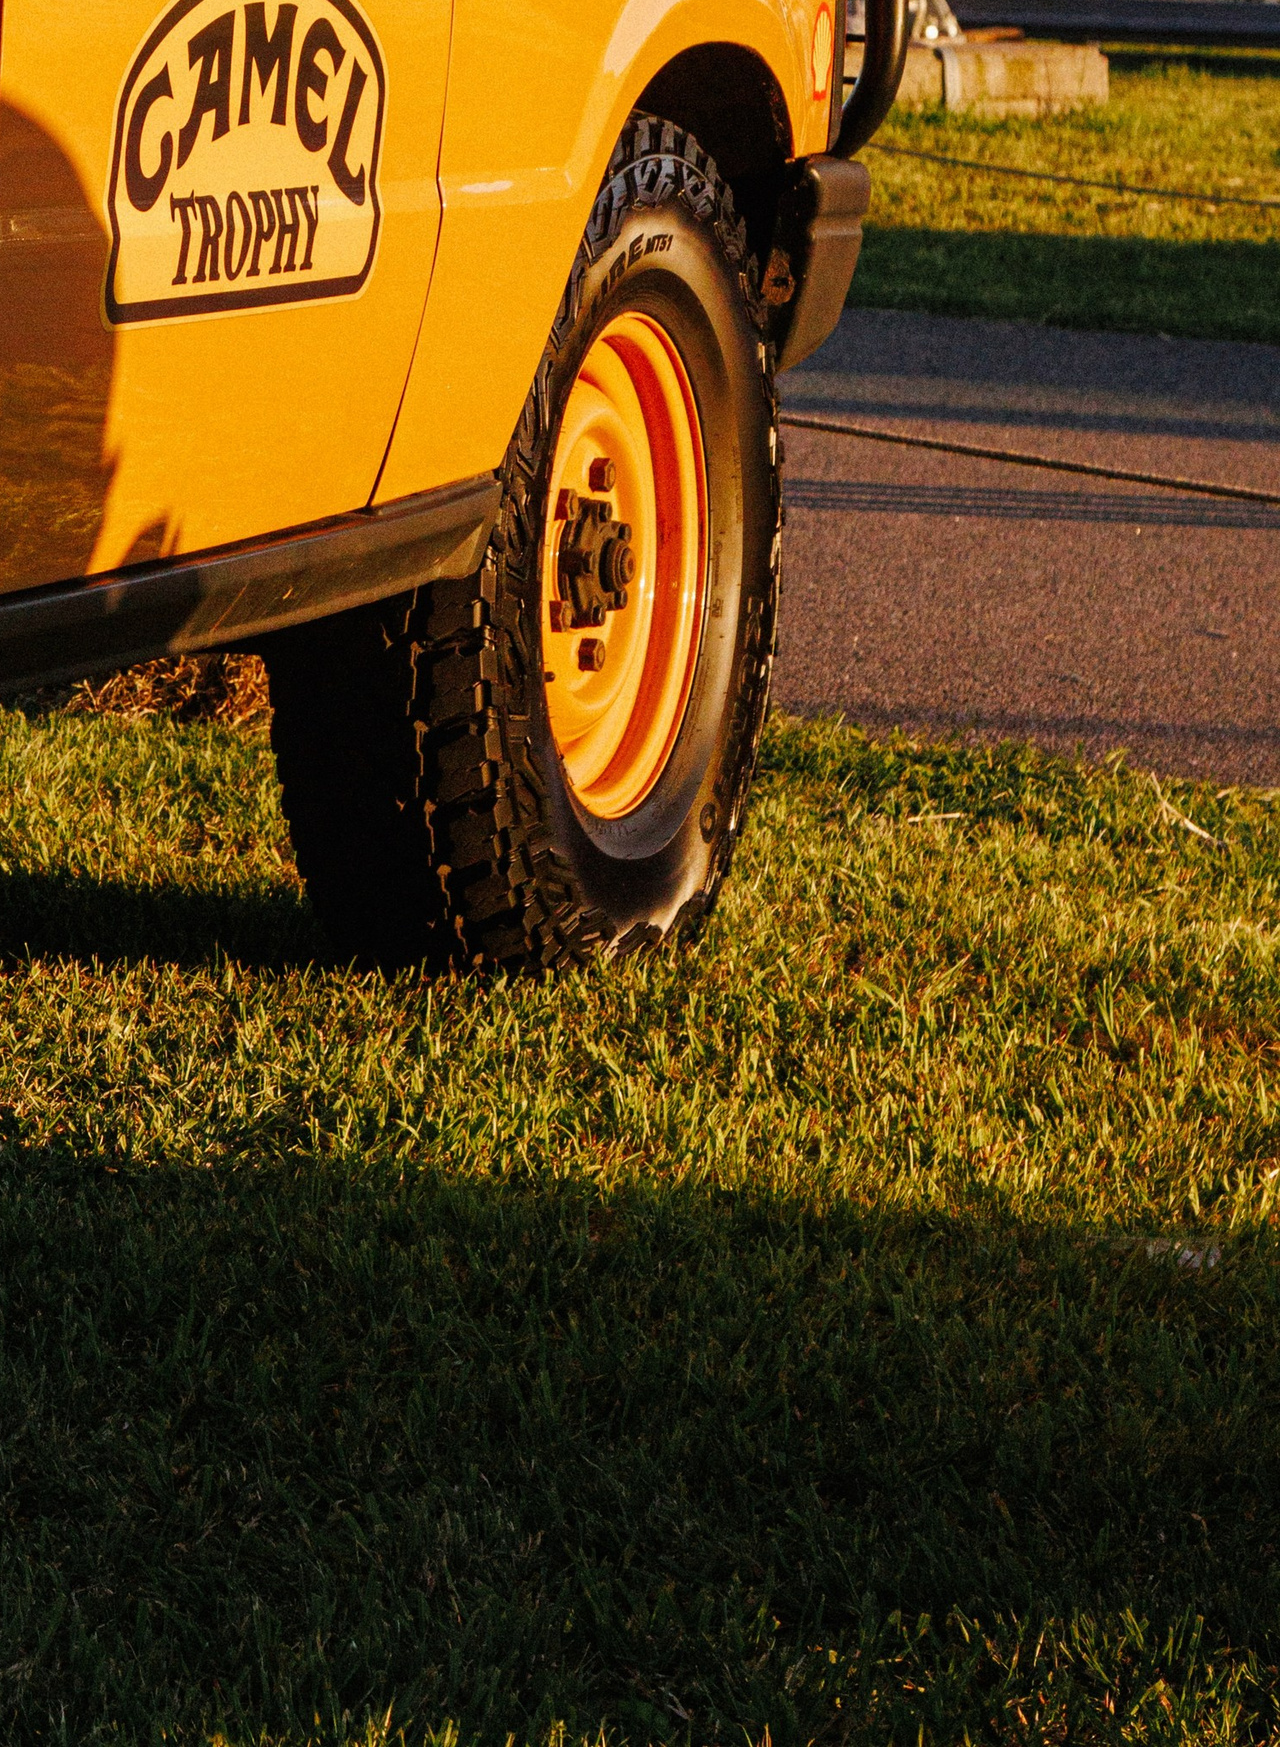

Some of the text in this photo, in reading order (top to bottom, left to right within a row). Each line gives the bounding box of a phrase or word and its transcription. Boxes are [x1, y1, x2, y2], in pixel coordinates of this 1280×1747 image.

[124, 1, 368, 212] CAMEL
[170, 185, 319, 287] TROPHY
[644, 233, 674, 256] MT51
